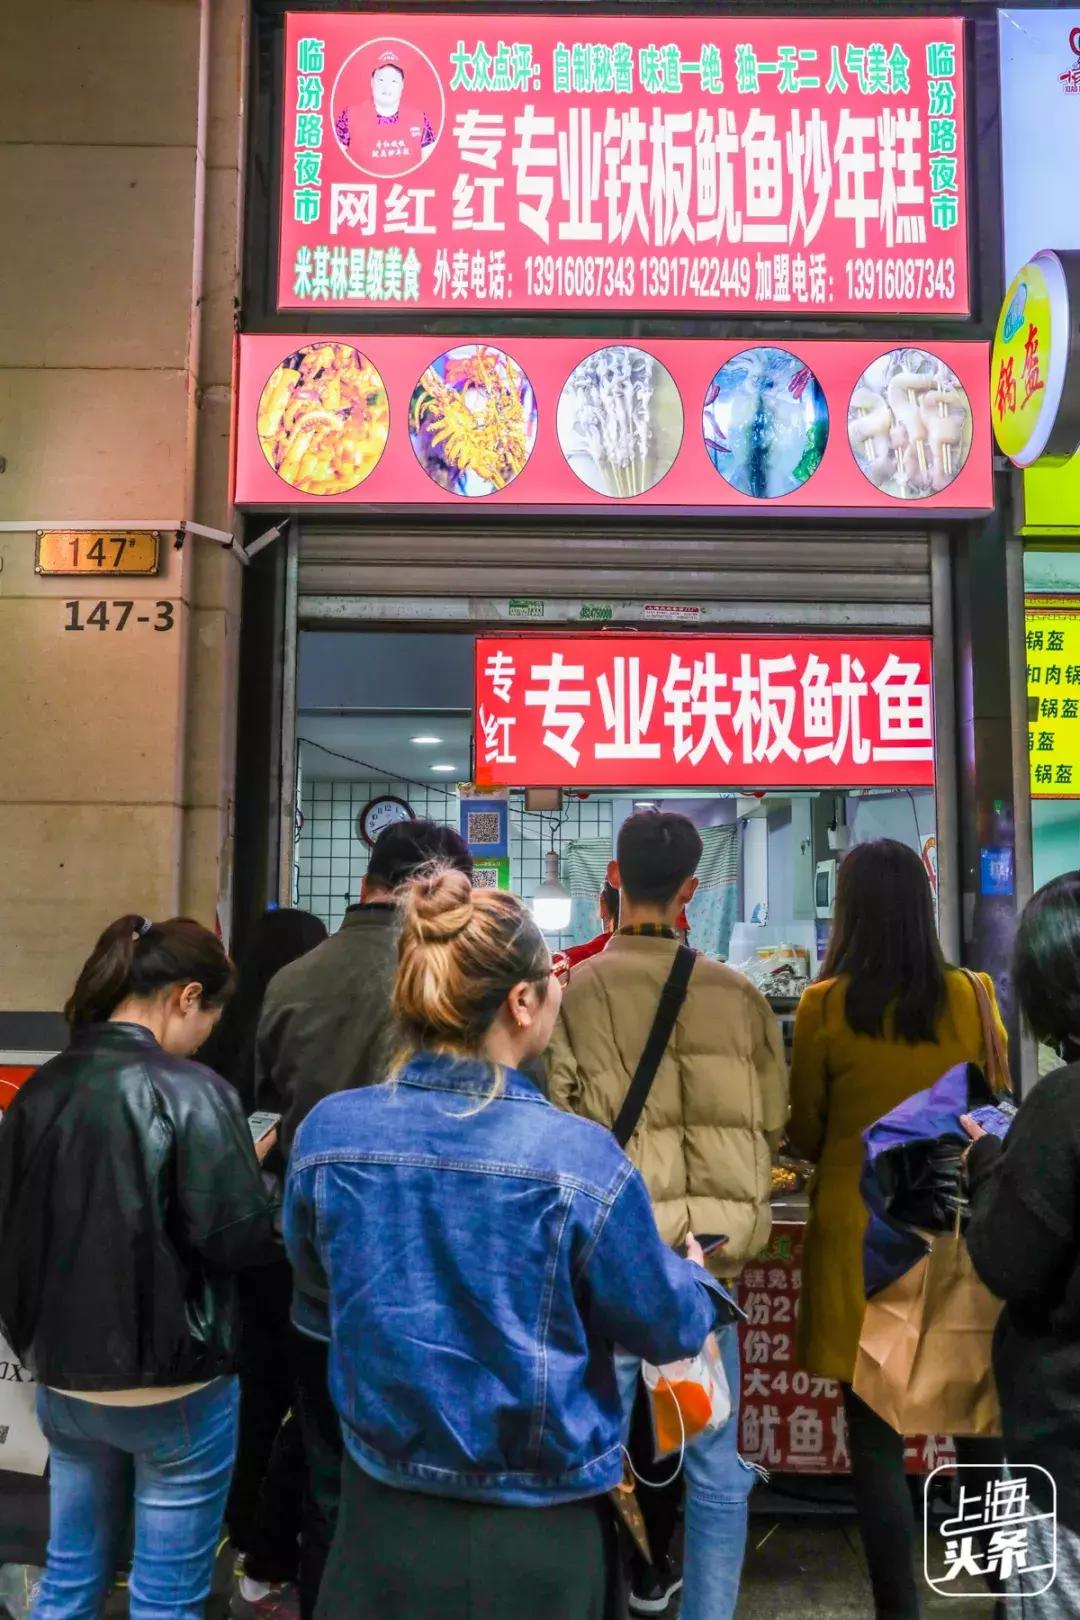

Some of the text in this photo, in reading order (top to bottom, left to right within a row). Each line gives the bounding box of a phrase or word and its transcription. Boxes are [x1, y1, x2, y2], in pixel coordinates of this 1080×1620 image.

[553, 42, 634, 94] 自制秘酱
[639, 44, 723, 94] 味道一绝
[735, 44, 820, 94] 独一无二
[825, 43, 910, 95] 人气美食
[294, 38, 325, 224] 临汾路夜市
[926, 42, 959, 231] 临汾路夜市
[512, 104, 927, 248] 专业铁板鱿鱼炒年糕
[329, 183, 438, 235] 网红
[294, 246, 422, 301] 米其林星级美食
[525, 256, 635, 297] 13916087343
[640, 256, 750, 298] 13917422449
[846, 258, 955, 299] 13916087343
[64, 600, 175, 631] 147-3
[524, 652, 934, 768] 专业铁板鱿鱼
[1035, 763, 1073, 784] 锅盔
[744, 1292, 801, 1325] 份2
[744, 1368, 839, 1398] 大40元
